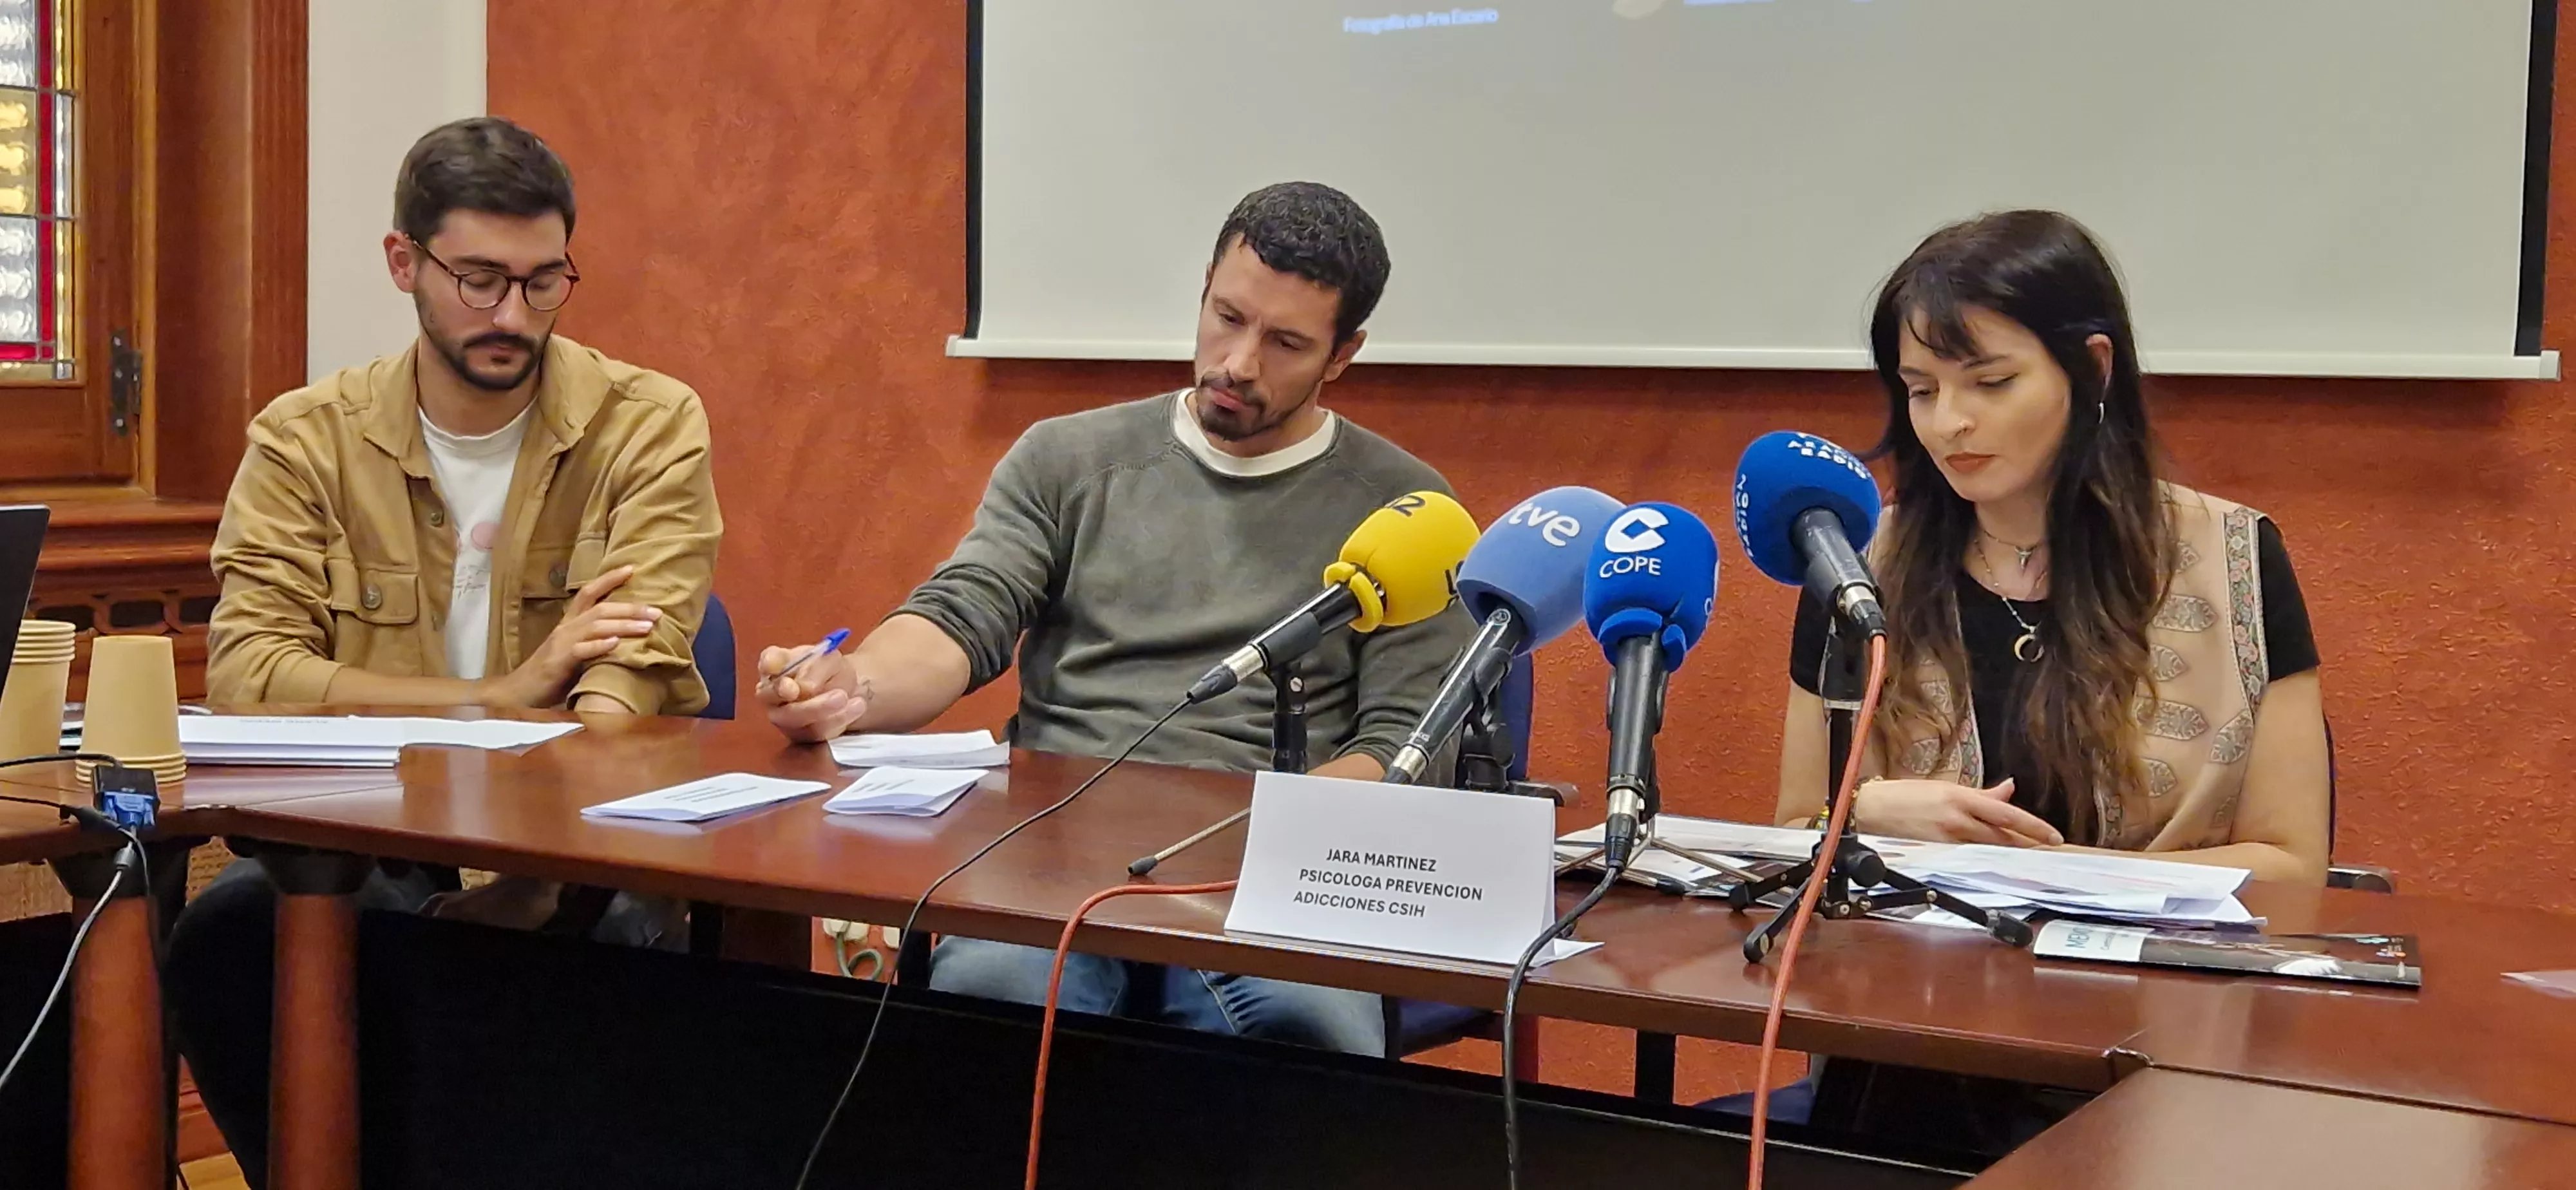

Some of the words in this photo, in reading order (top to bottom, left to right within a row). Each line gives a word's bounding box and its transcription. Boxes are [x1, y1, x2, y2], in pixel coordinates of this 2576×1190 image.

[1508, 502, 1580, 546] tve
[1600, 556, 1662, 578] COPE
[1327, 849, 1360, 864] JARA
[1364, 853, 1437, 872] MARTINEZ
[1300, 869, 1382, 889] PSICOLOGA
[1385, 878, 1482, 900] PREVENCION
[1294, 891, 1385, 913] ADICCIONES
[1388, 902, 1425, 918] CSIH
